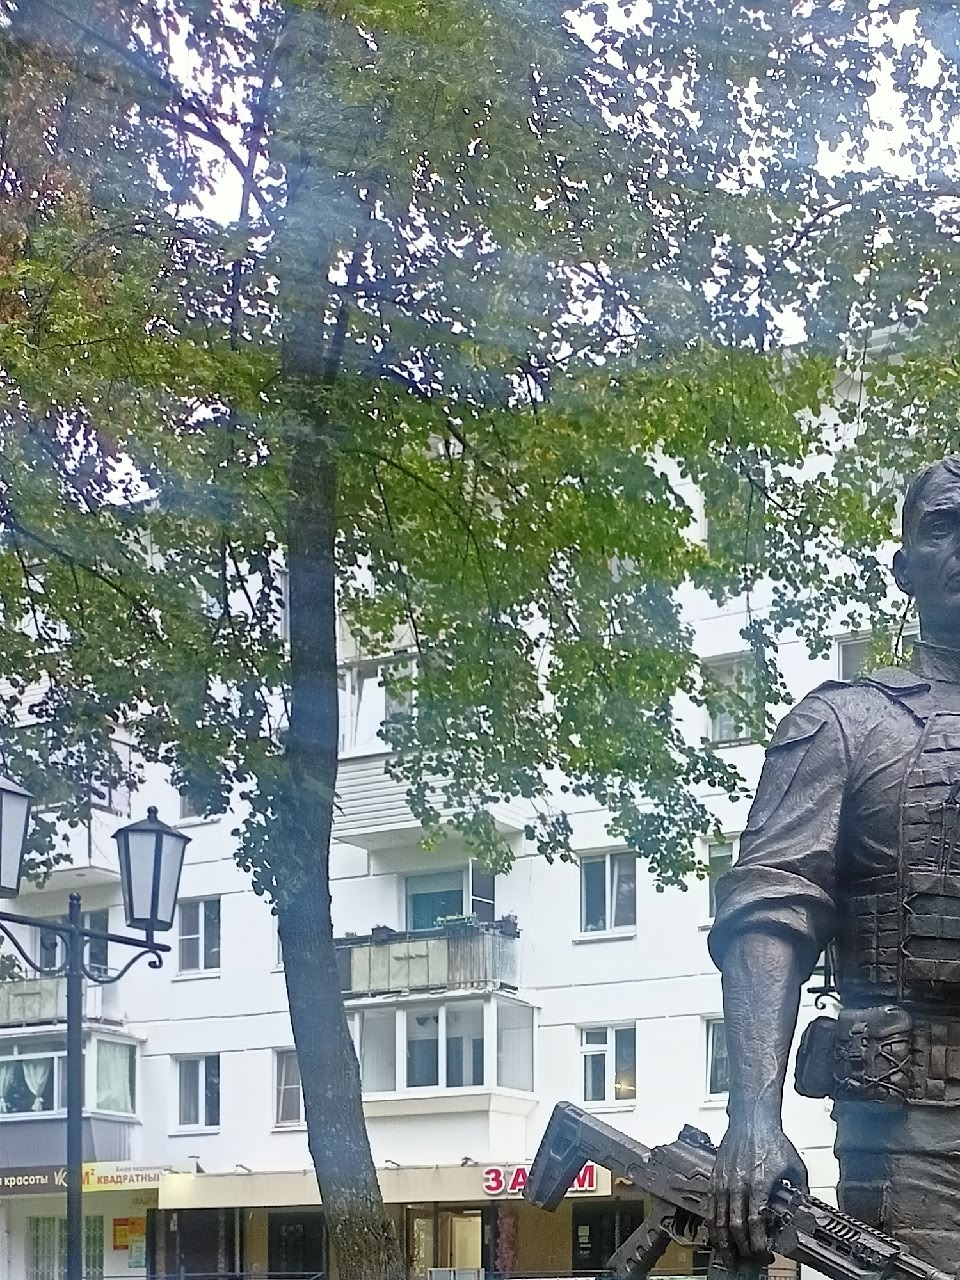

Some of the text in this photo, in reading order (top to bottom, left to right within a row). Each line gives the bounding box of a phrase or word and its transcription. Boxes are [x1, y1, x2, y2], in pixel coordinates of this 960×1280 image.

[3, 1175, 48, 1188] красоты
[97, 1173, 159, 1185] КВАДРАТНЫ
[484, 1165, 595, 1193] ЗАМ
